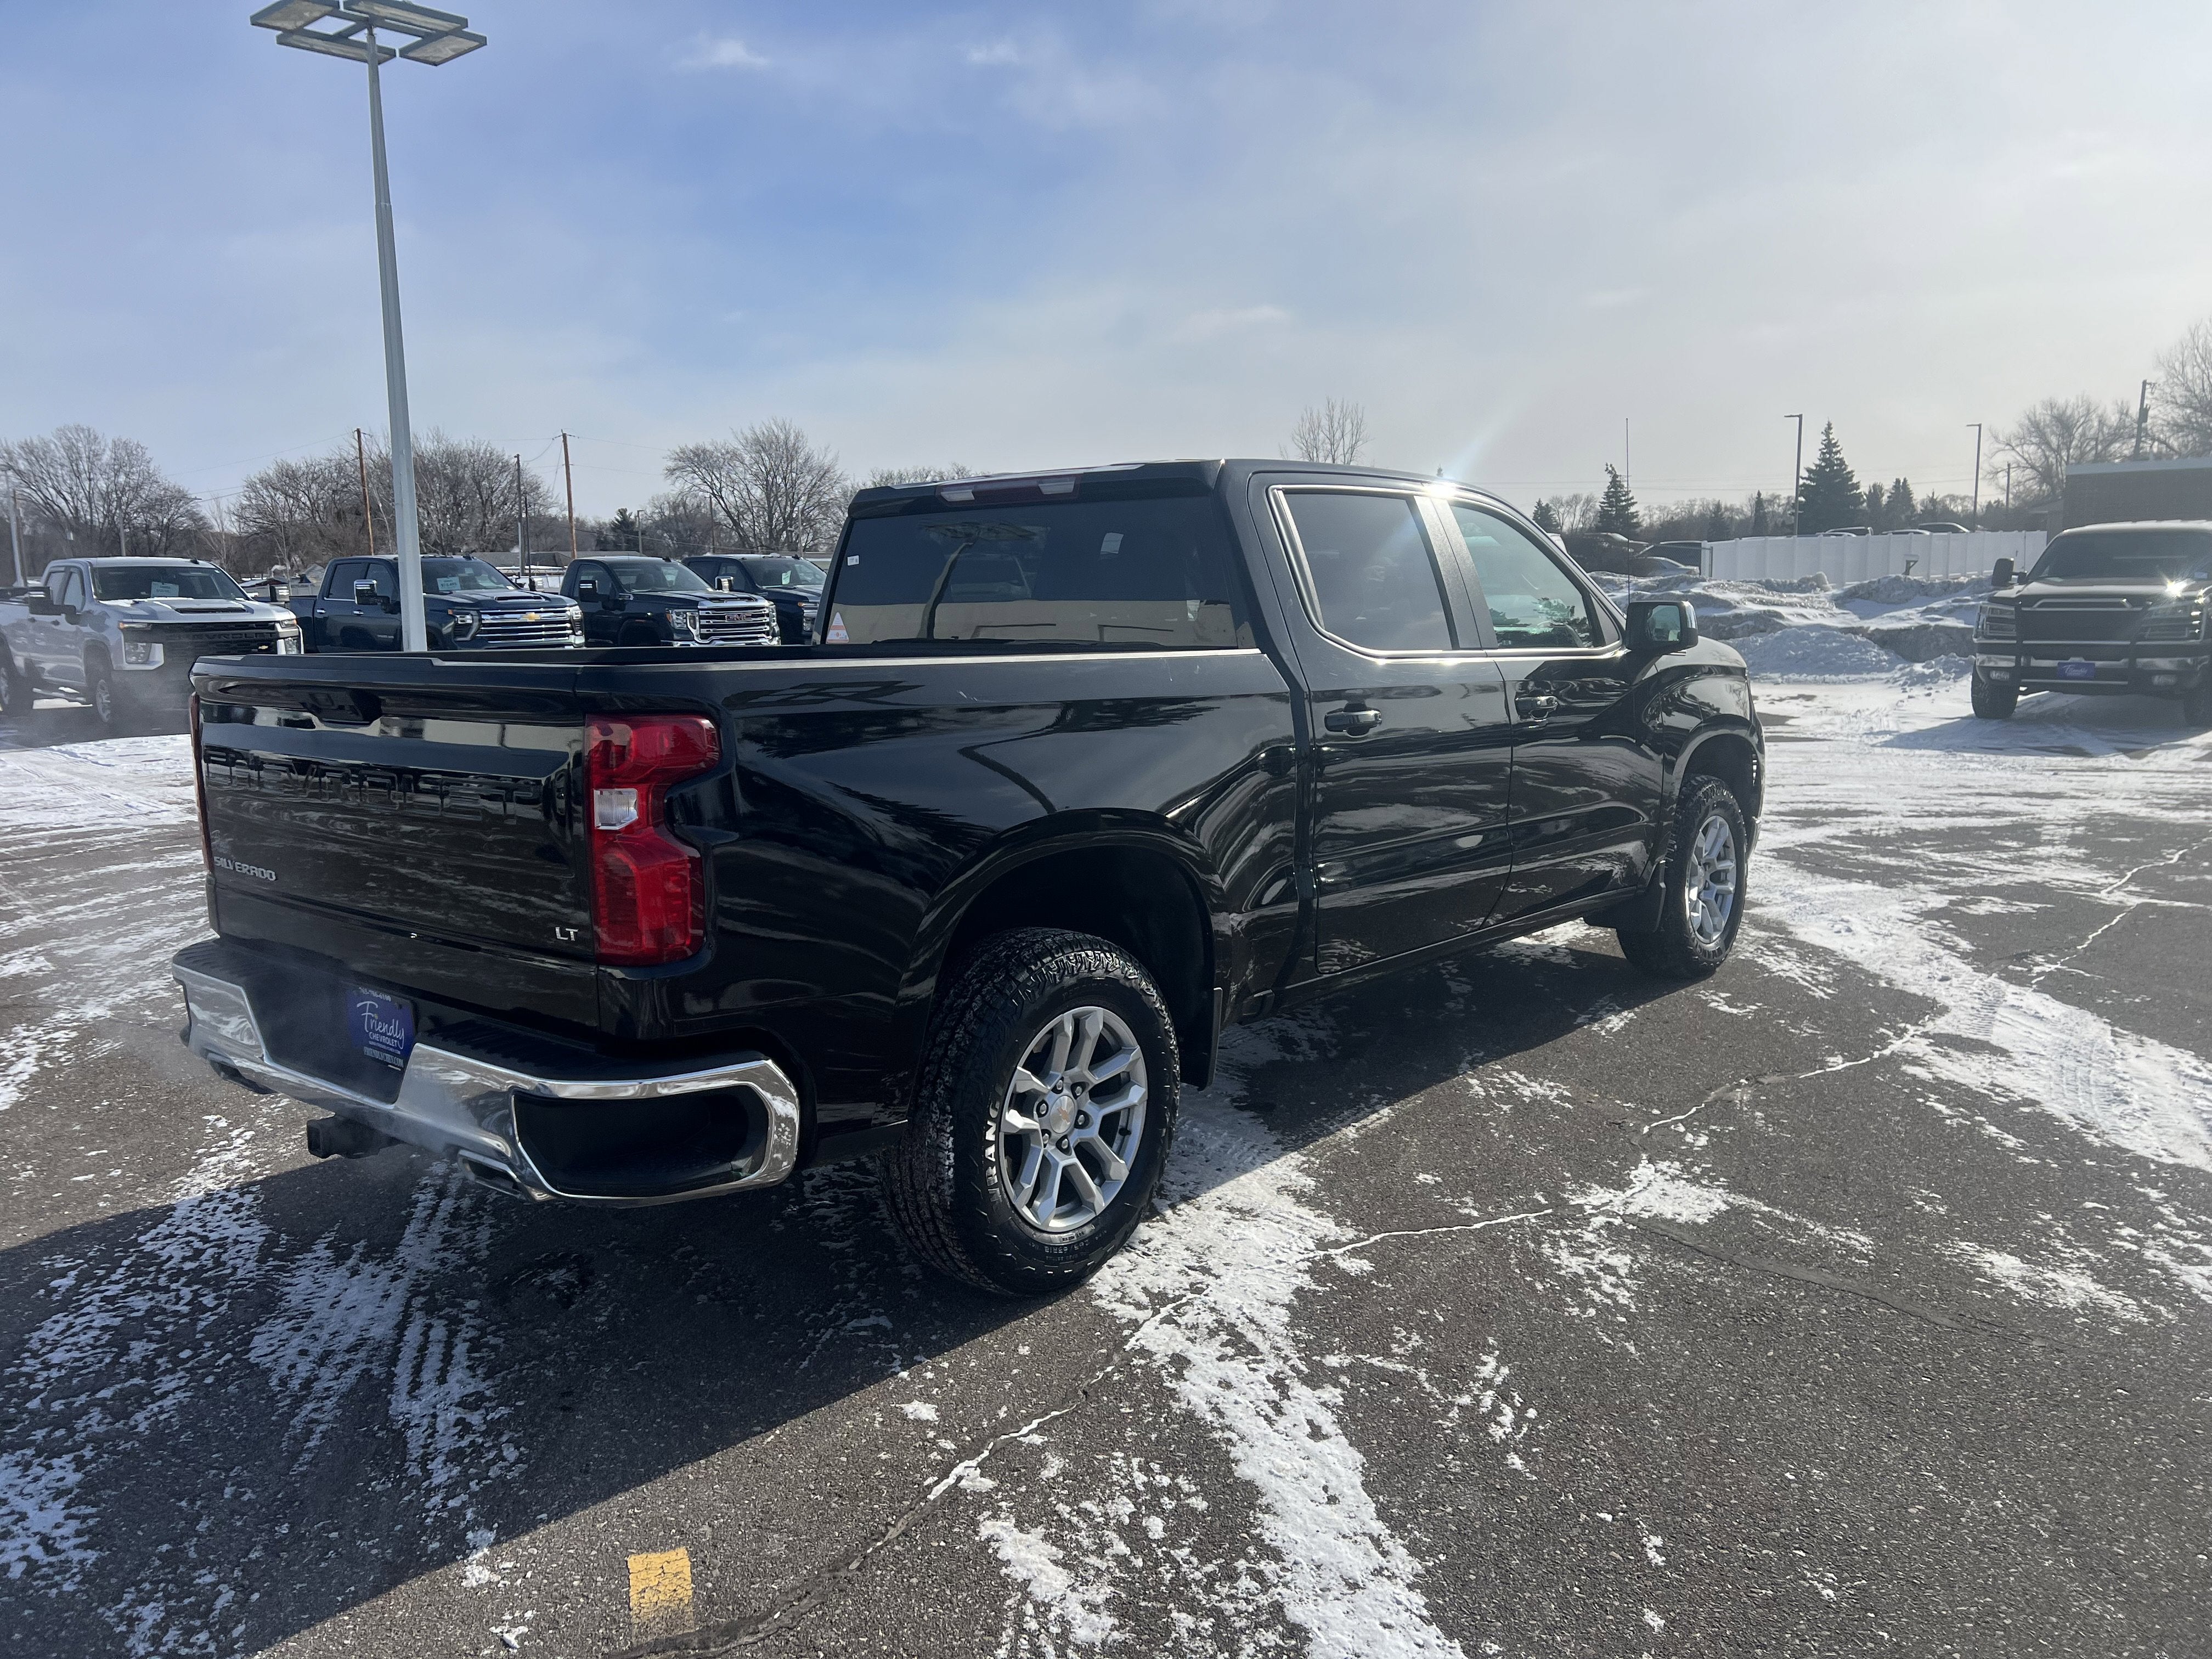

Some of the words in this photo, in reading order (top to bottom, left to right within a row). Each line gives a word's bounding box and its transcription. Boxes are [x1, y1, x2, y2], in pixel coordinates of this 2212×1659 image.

[214, 856, 276, 881] SILVERADO
[555, 927, 579, 941] LT
[357, 1001, 405, 1049] Friendly
[369, 1031, 397, 1047] CHEVROLET
